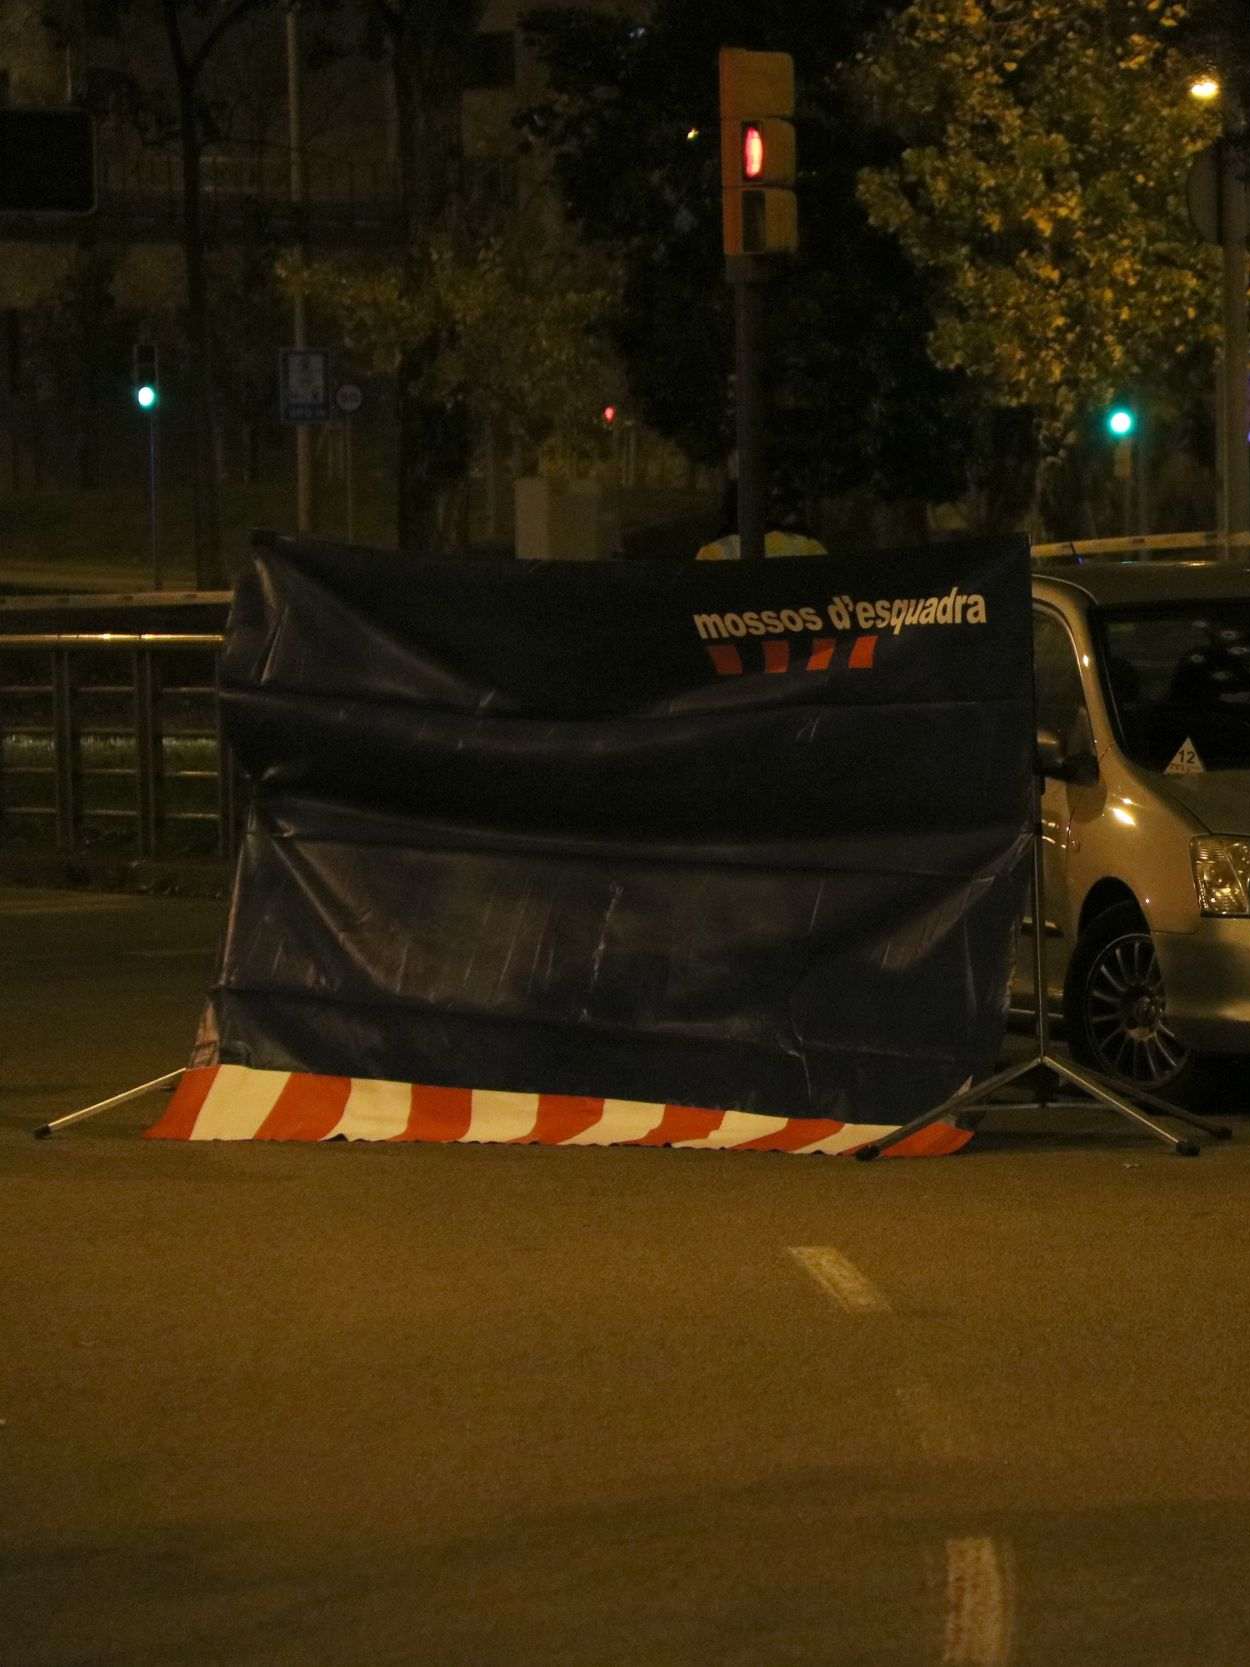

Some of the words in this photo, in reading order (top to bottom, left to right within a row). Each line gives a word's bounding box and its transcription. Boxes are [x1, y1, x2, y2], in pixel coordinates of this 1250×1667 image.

[693, 606, 823, 639] mossos
[829, 587, 987, 635] d'esquadra
[1179, 750, 1196, 764] 12
